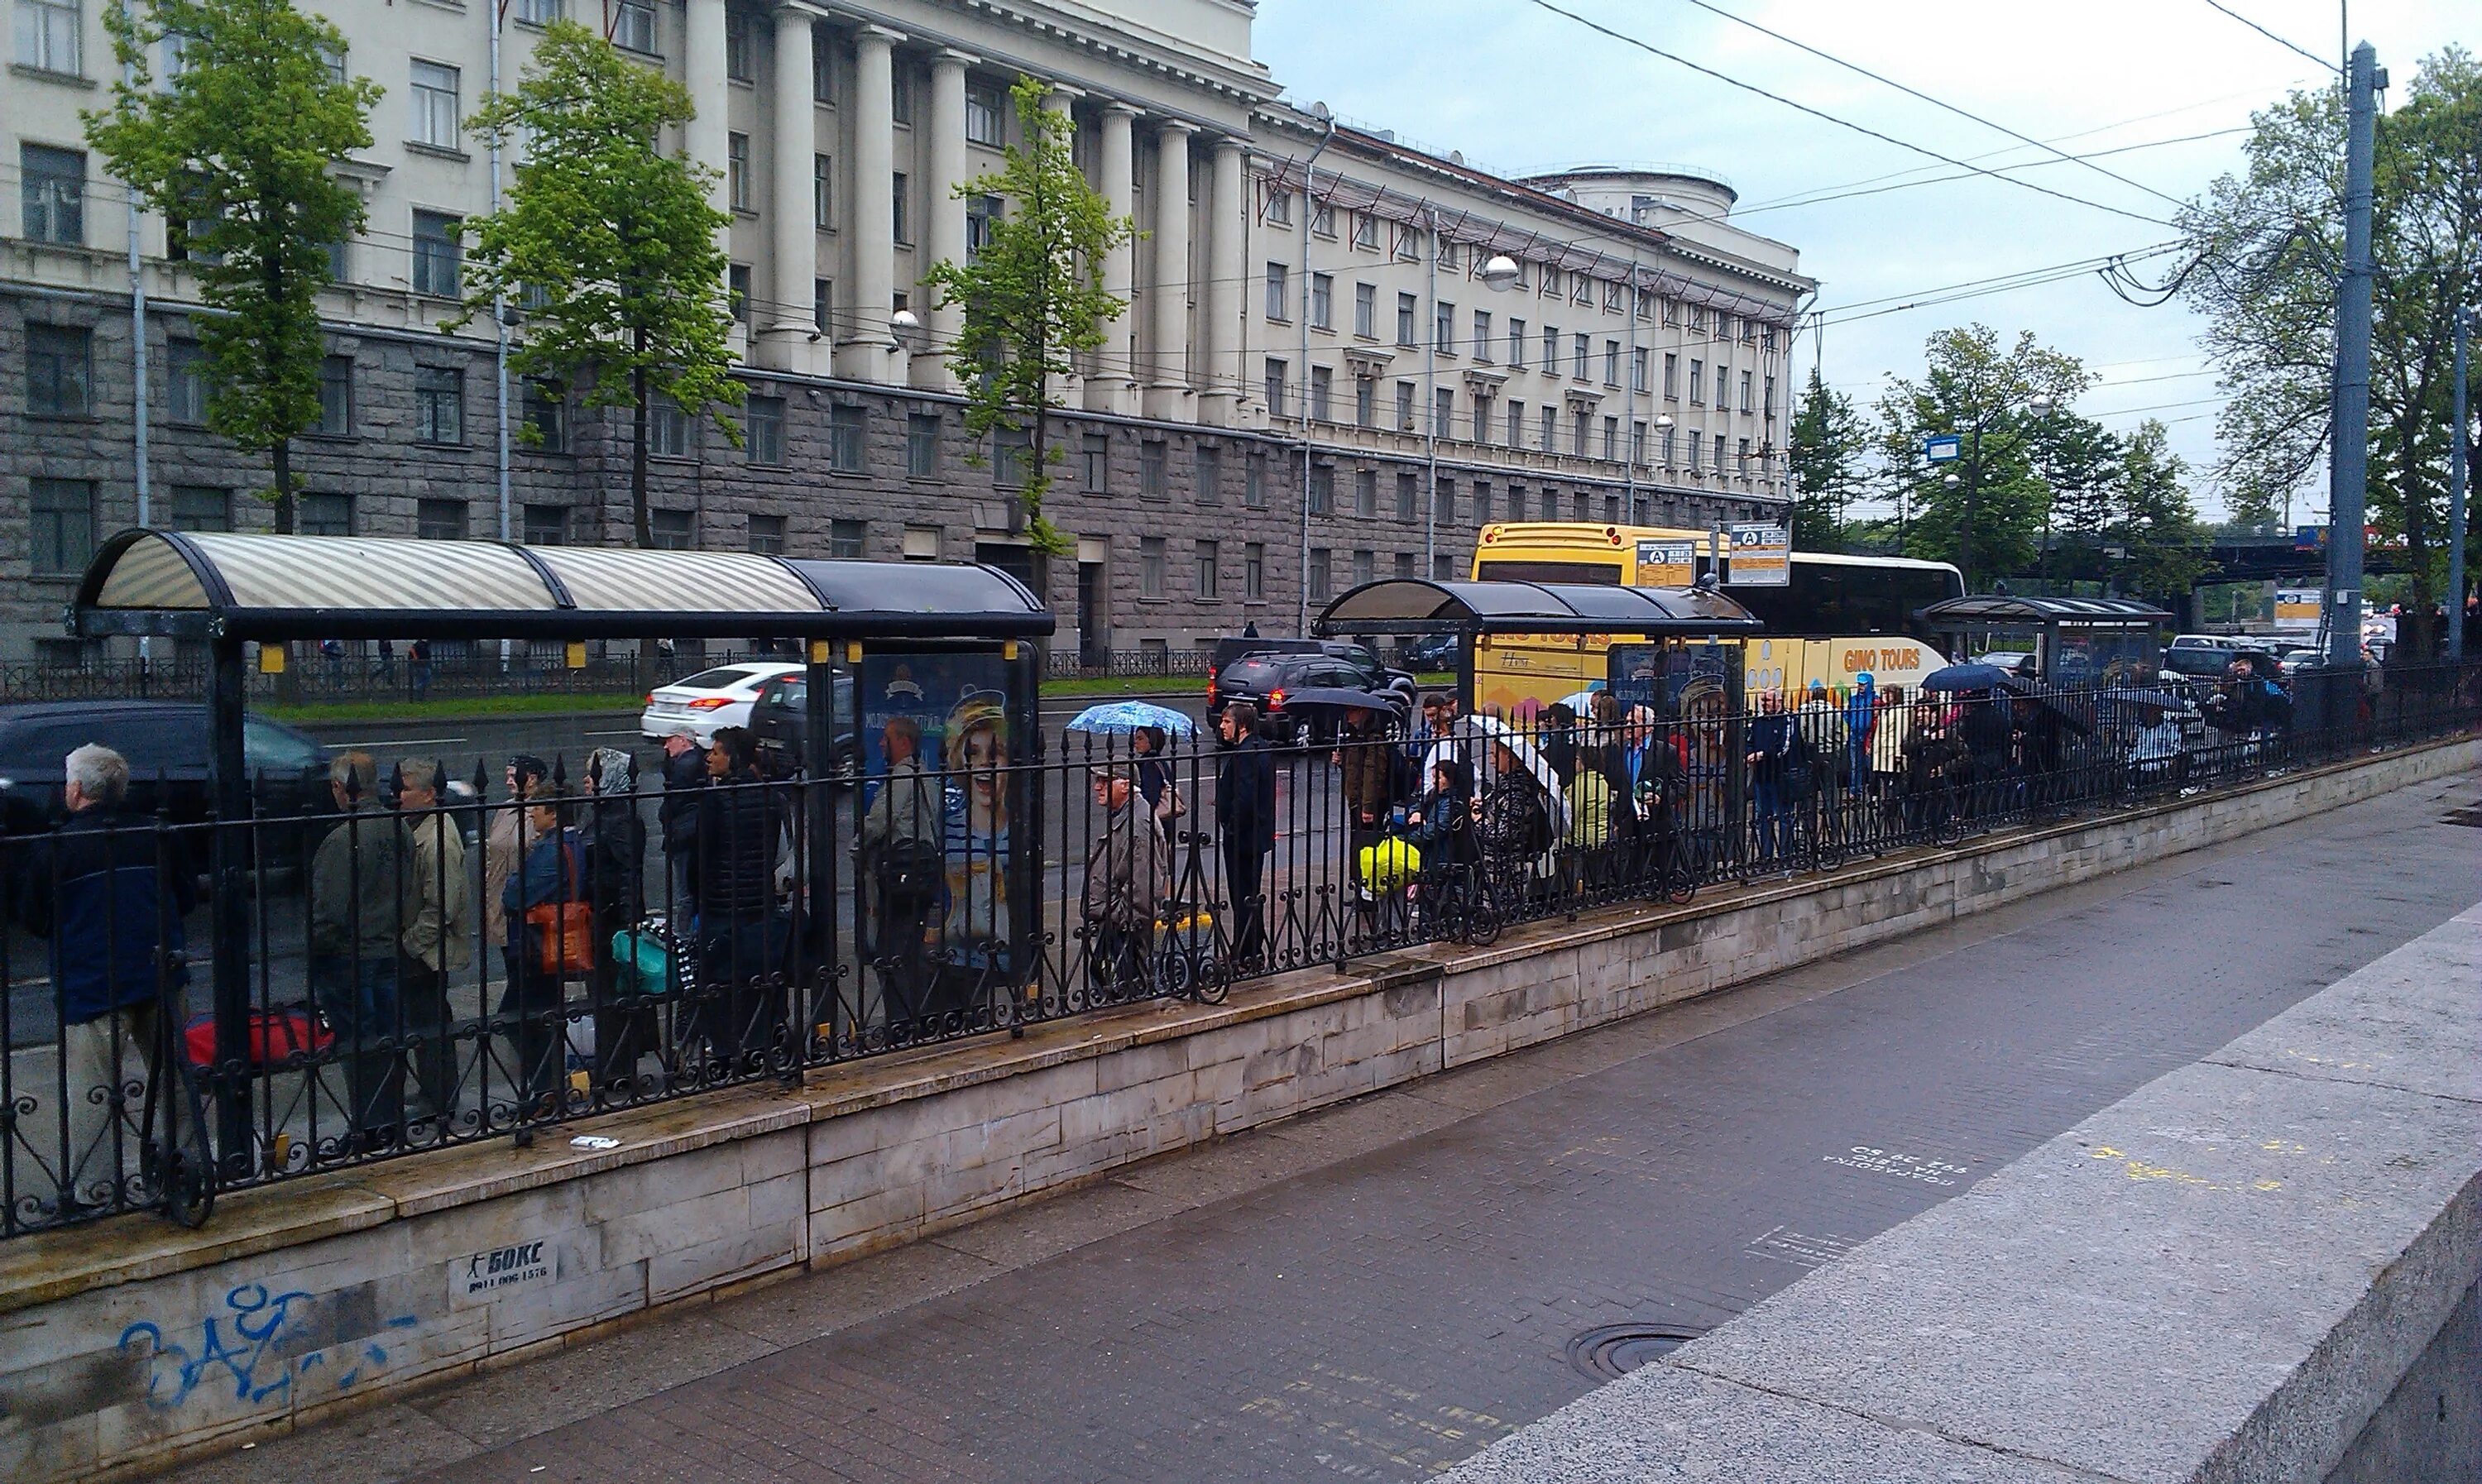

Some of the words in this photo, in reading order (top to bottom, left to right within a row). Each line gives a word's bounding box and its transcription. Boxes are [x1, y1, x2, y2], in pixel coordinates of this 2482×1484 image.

[1844, 649, 1876, 672] GINO
[1880, 648, 1920, 671] TOURS
[487, 1241, 544, 1274] БОКС
[522, 1267, 547, 1281] 1576
